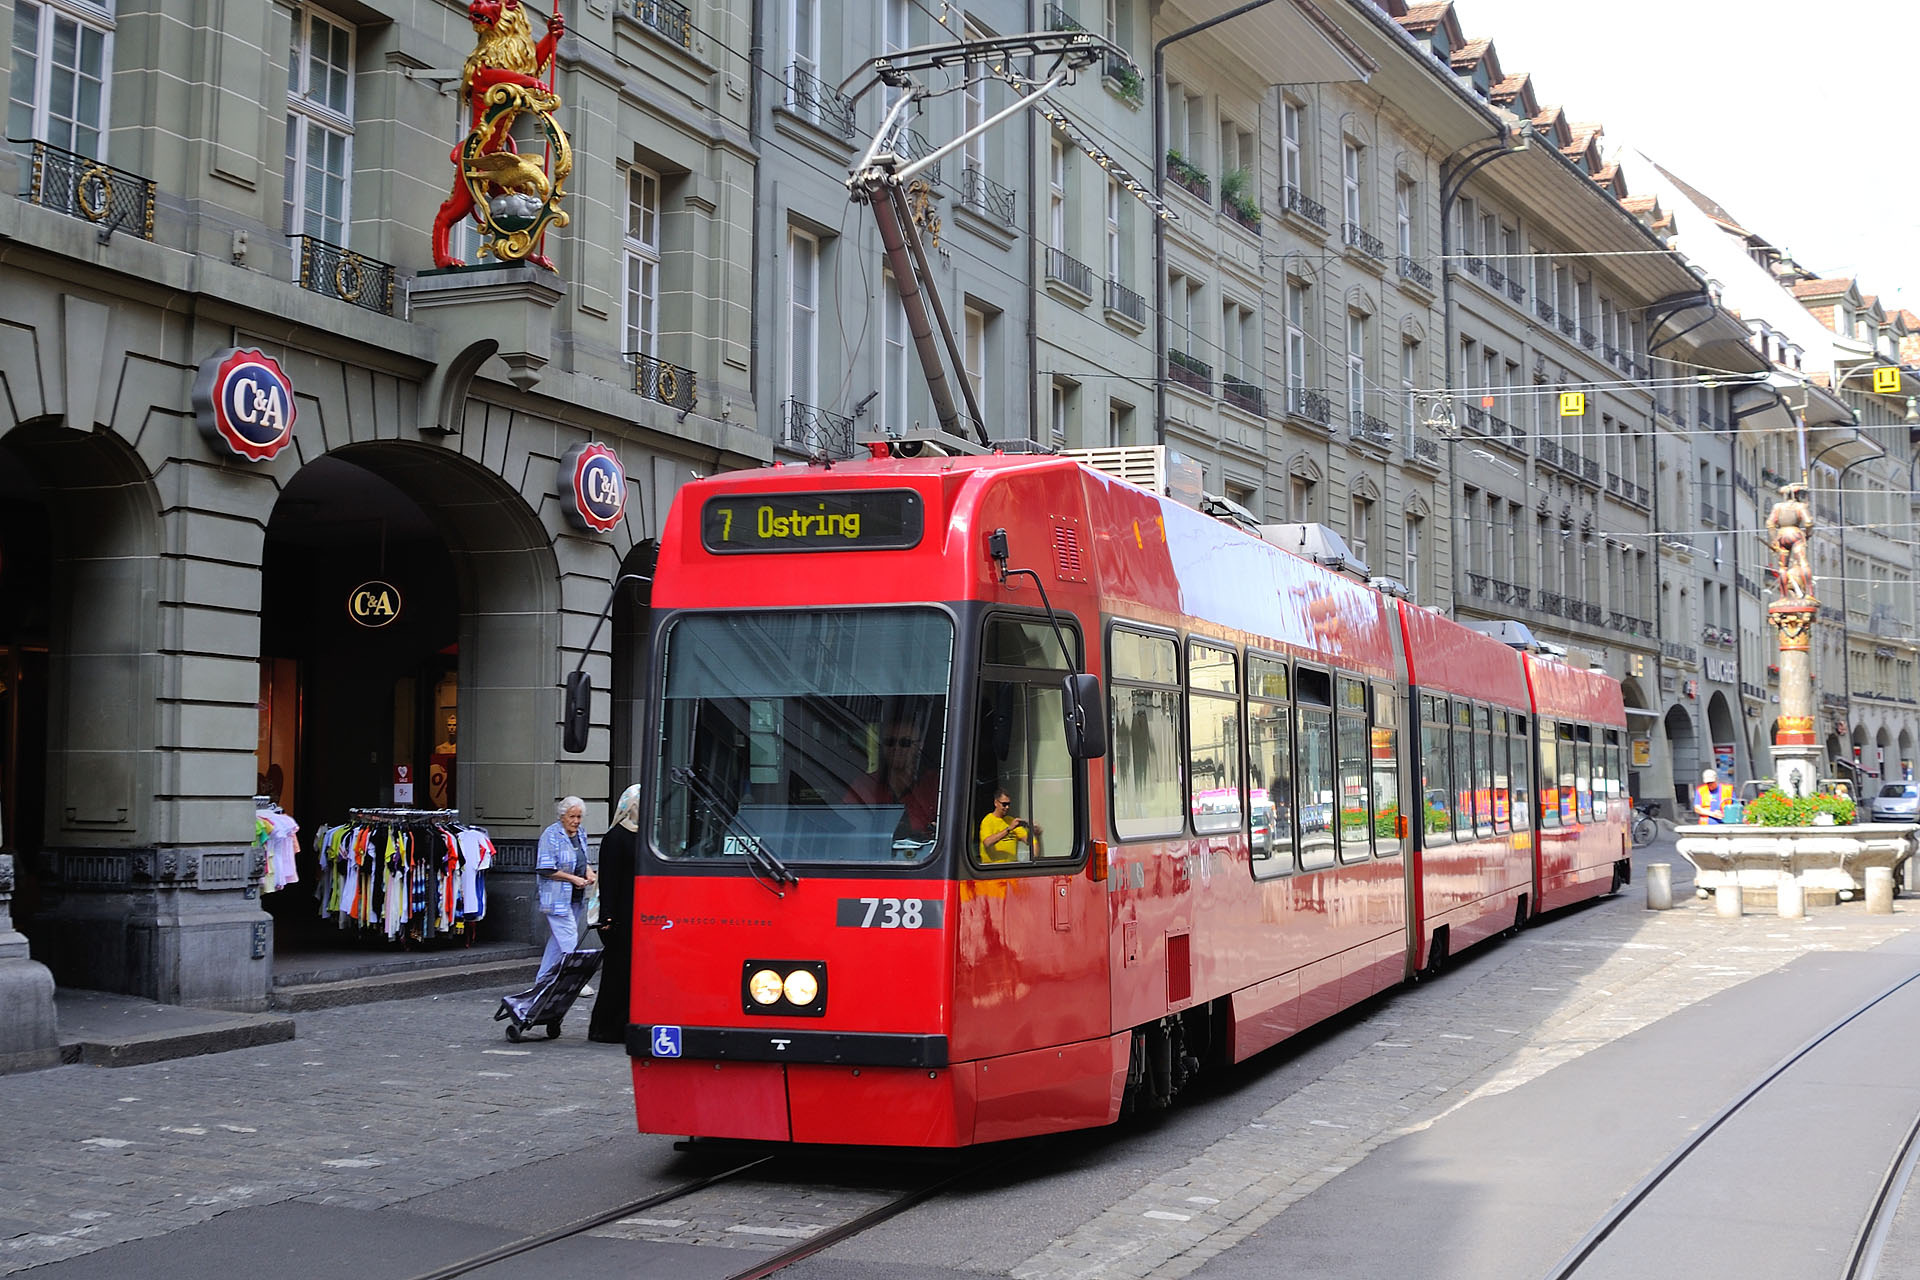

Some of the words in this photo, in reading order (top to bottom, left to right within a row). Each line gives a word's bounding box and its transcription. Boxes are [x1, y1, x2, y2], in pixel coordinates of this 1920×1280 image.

[233, 378, 284, 430] C&A
[588, 467, 621, 507] C&A
[717, 508, 732, 541] 7
[757, 503, 860, 538] Ostring
[354, 590, 394, 616] C&A
[640, 913, 668, 924] bern
[676, 917, 715, 925] UNESCO
[859, 898, 923, 929] 738
